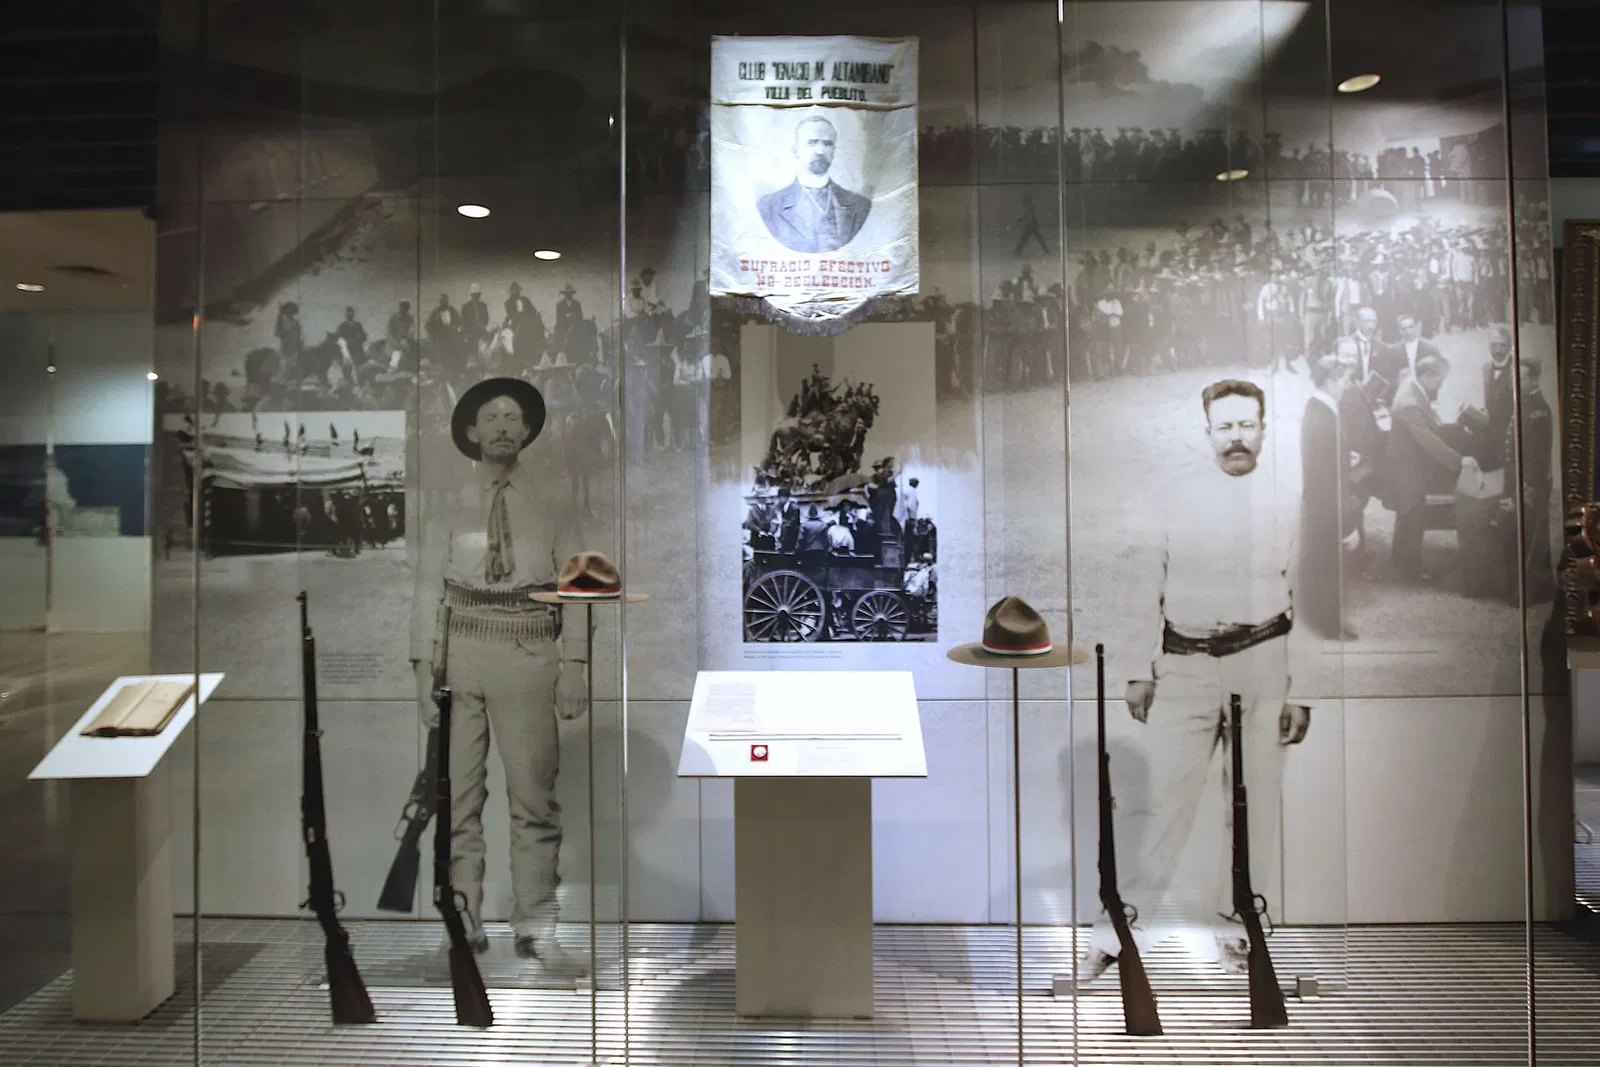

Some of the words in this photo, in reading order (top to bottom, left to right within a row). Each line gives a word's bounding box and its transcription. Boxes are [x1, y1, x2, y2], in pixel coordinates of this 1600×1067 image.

[739, 61, 766, 81] CLUB
[764, 86, 790, 100] VILLA
[797, 86, 813, 100] DEL
[819, 259, 890, 274] EFECTIVO
